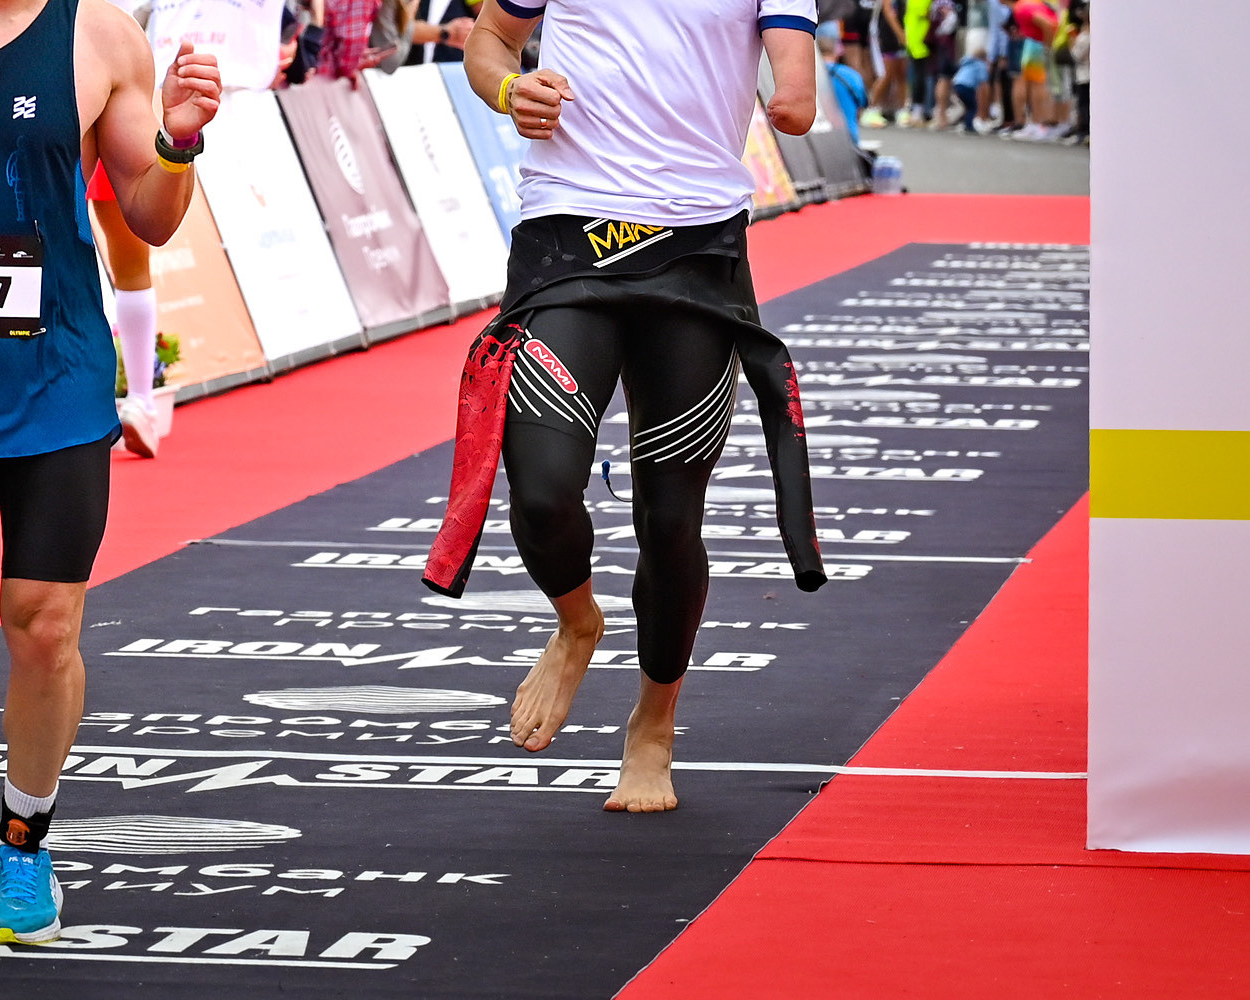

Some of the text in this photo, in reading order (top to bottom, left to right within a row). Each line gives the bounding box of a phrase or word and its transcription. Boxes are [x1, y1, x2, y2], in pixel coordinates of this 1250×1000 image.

[587, 221, 665, 259] MAK
[532, 345, 572, 386] NAMI
[188, 607, 811, 630] Газпромбнк
[118, 639, 382, 657] IRON
[315, 764, 623, 787] STAR
[42, 925, 432, 960] STAR
